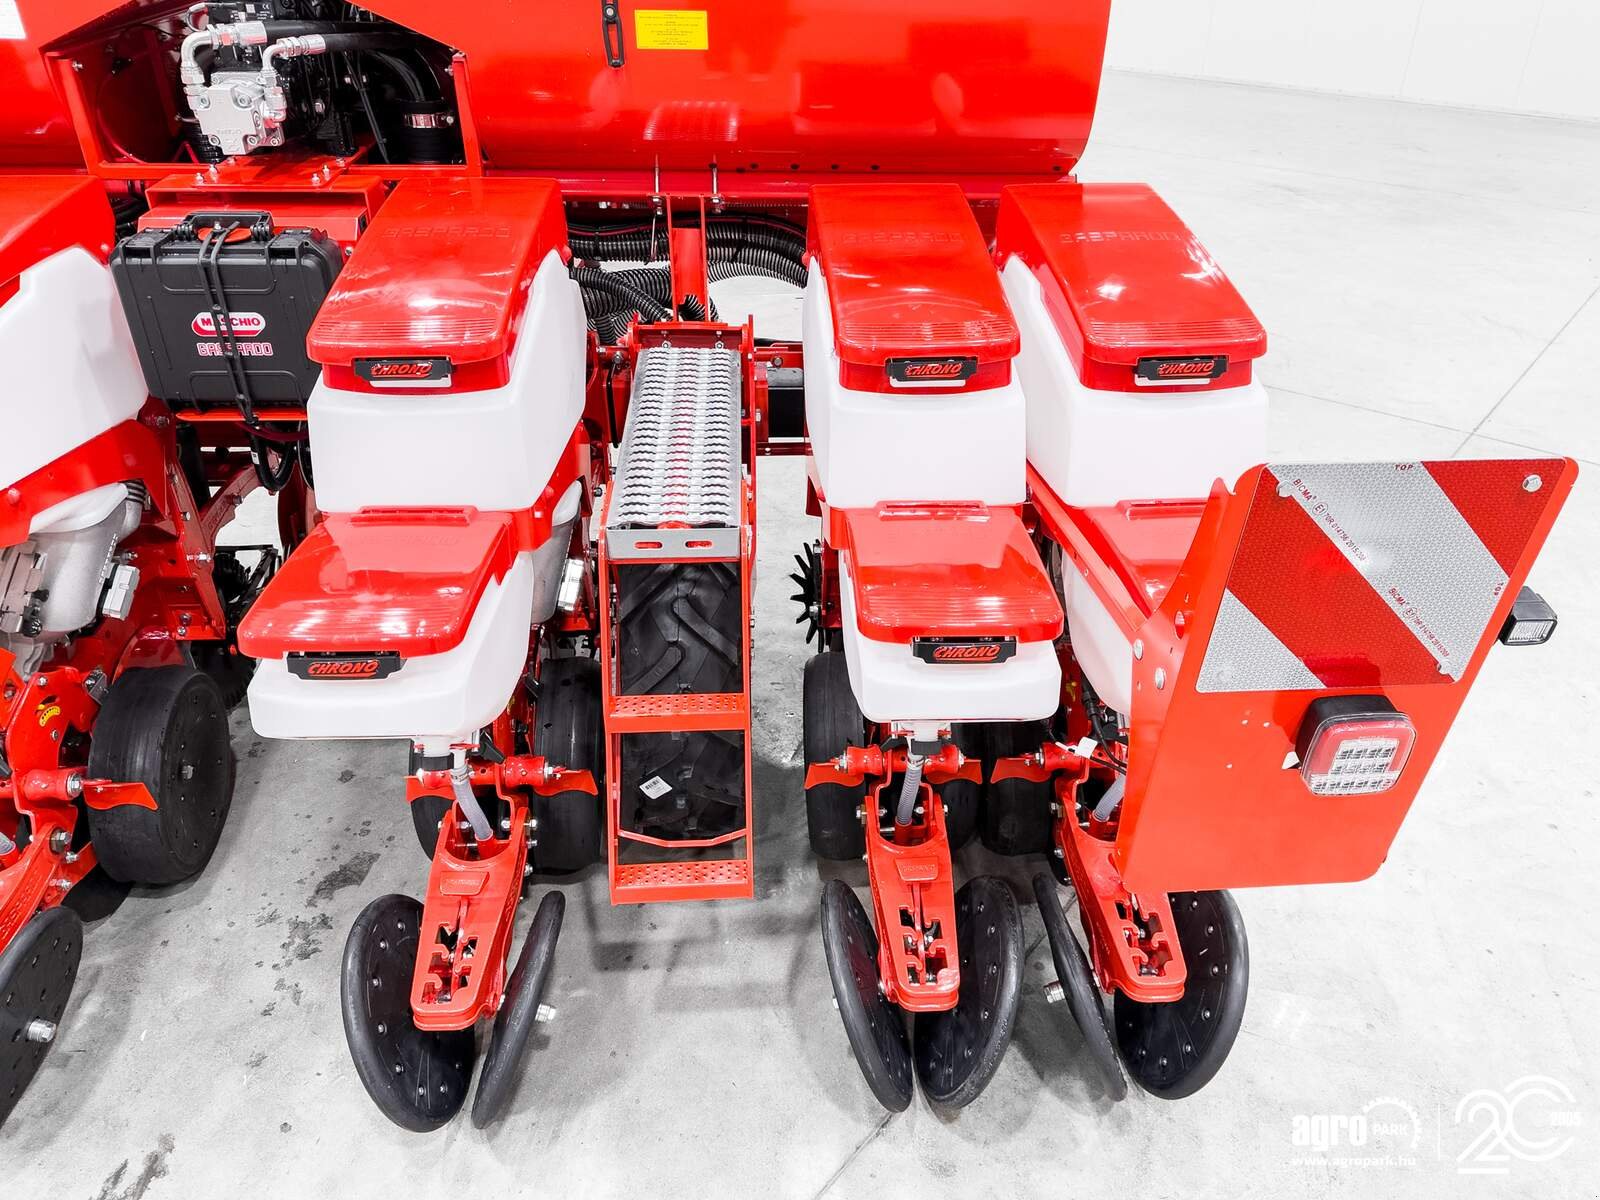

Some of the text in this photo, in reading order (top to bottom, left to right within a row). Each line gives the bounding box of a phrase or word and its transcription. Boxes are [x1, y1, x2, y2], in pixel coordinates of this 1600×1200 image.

[370, 362, 433, 377] CHRONO
[905, 362, 963, 377] CHRONO
[1157, 361, 1215, 377] CHRONO
[1394, 463, 1414, 471] TOP
[933, 644, 1001, 661] CHRONO
[307, 659, 379, 677] CHRONO
